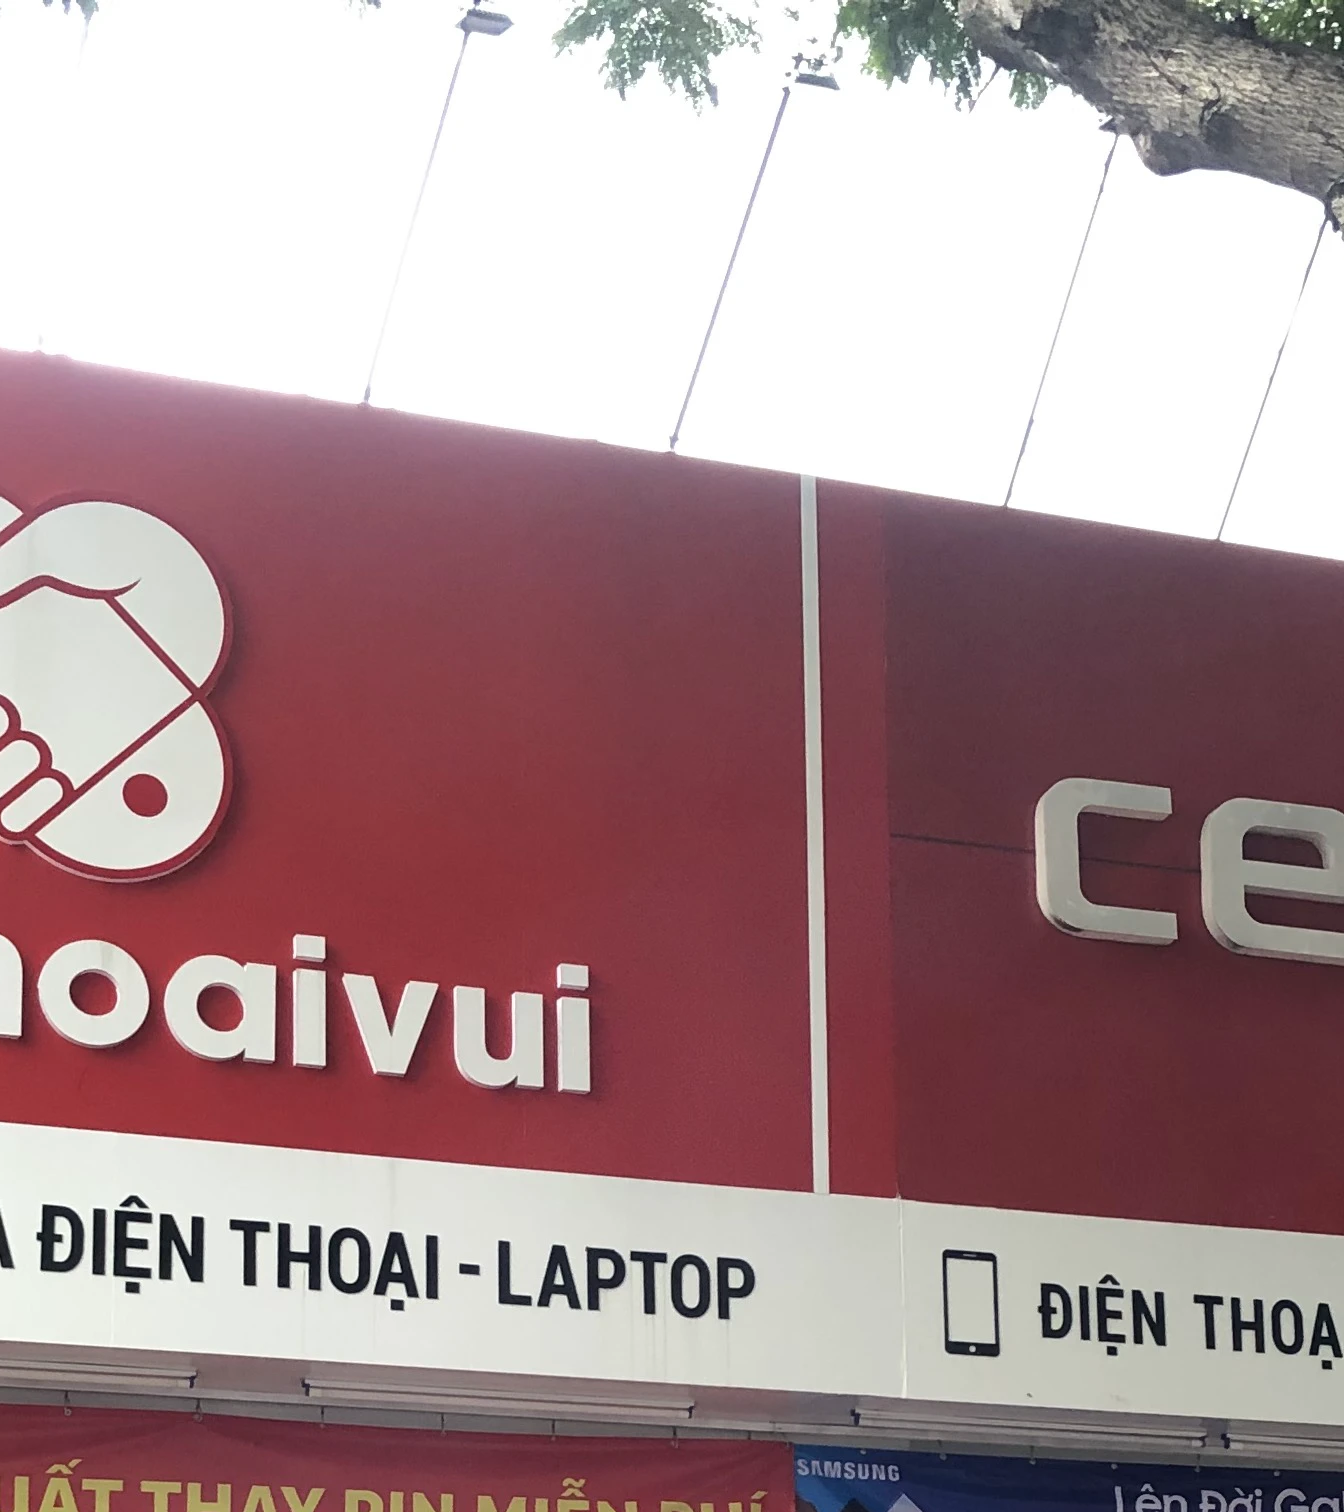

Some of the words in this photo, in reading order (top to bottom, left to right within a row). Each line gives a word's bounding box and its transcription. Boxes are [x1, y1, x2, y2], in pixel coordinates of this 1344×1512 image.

[36, 1195, 205, 1295] ĐIỆN
[228, 1217, 440, 1312] THOẠI
[497, 1240, 757, 1321] LAPTOP
[1036, 1274, 1167, 1356] ĐIỆN
[796, 1457, 901, 1483] SAMSUNG
